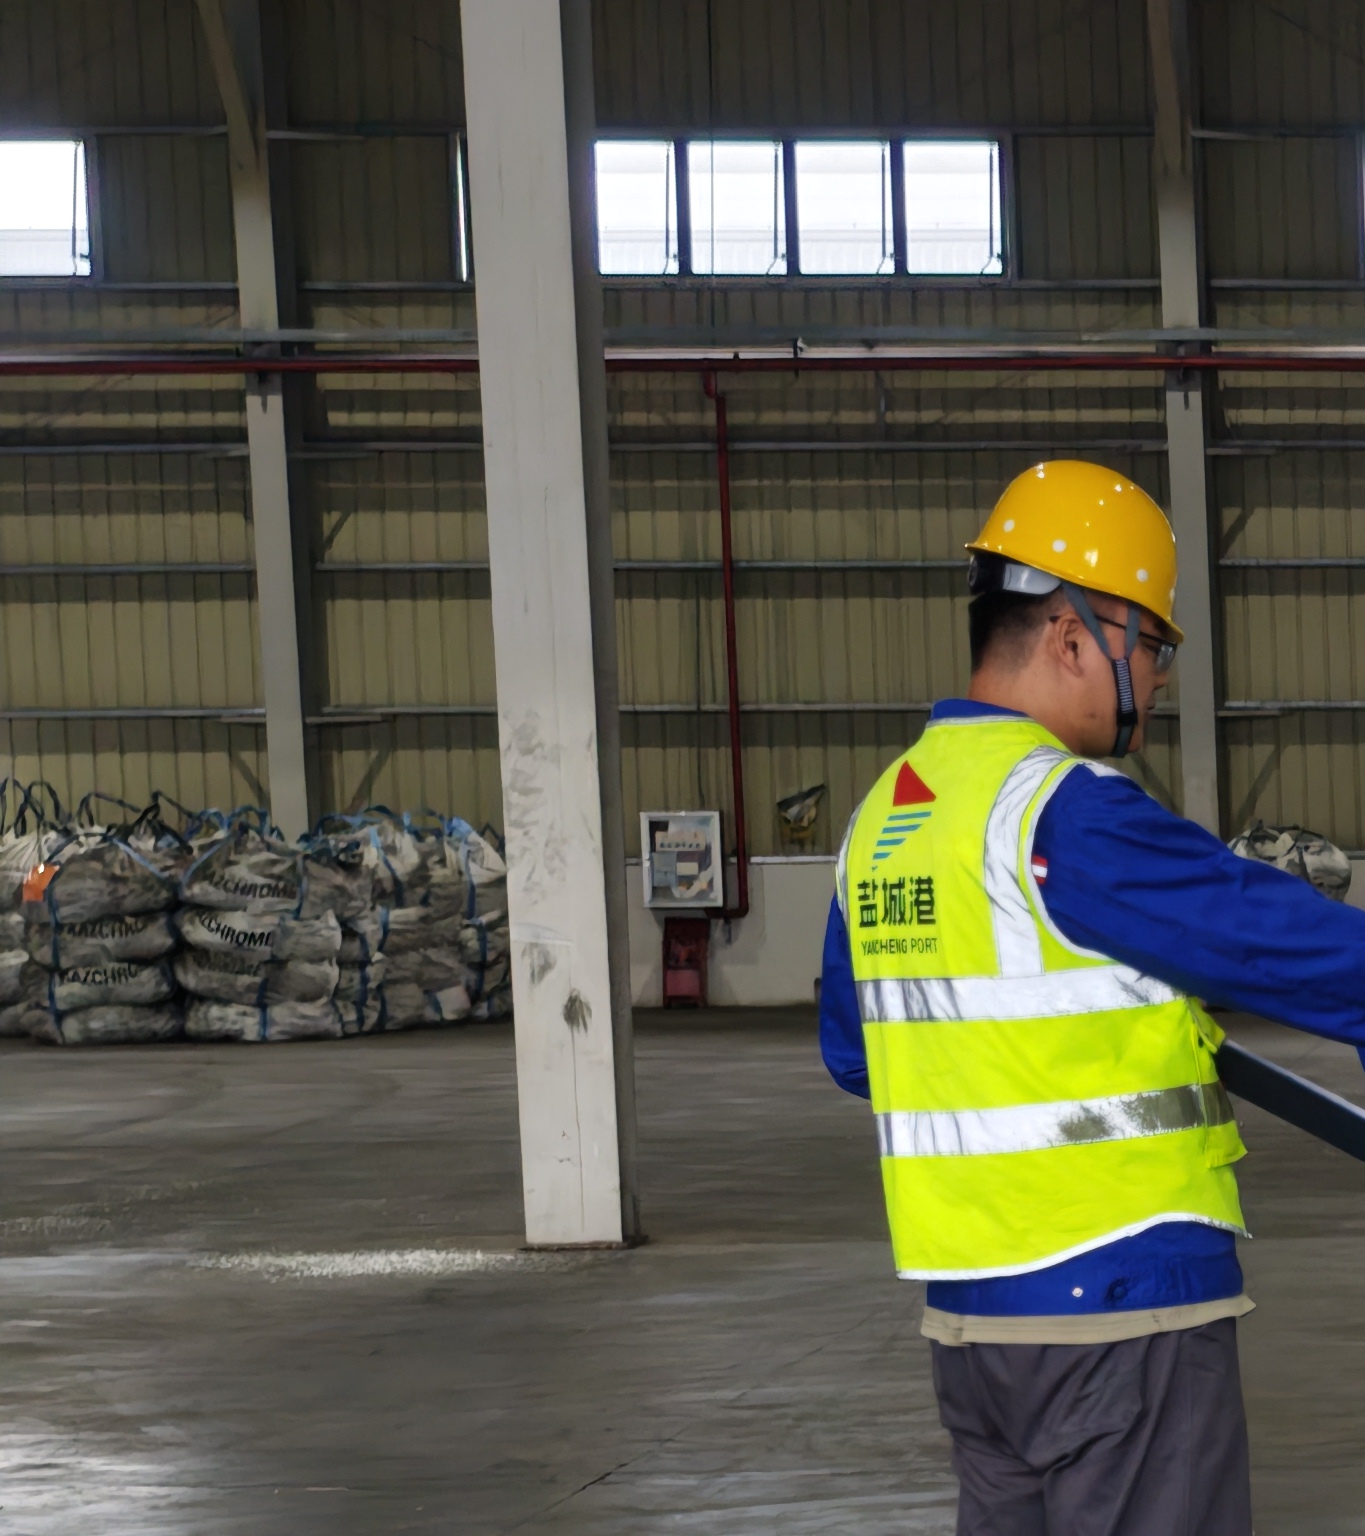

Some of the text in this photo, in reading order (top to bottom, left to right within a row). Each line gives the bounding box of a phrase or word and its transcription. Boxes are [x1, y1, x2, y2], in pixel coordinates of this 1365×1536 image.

[857, 876, 936, 928] 盐城港
[911, 937, 938, 954] PORT
